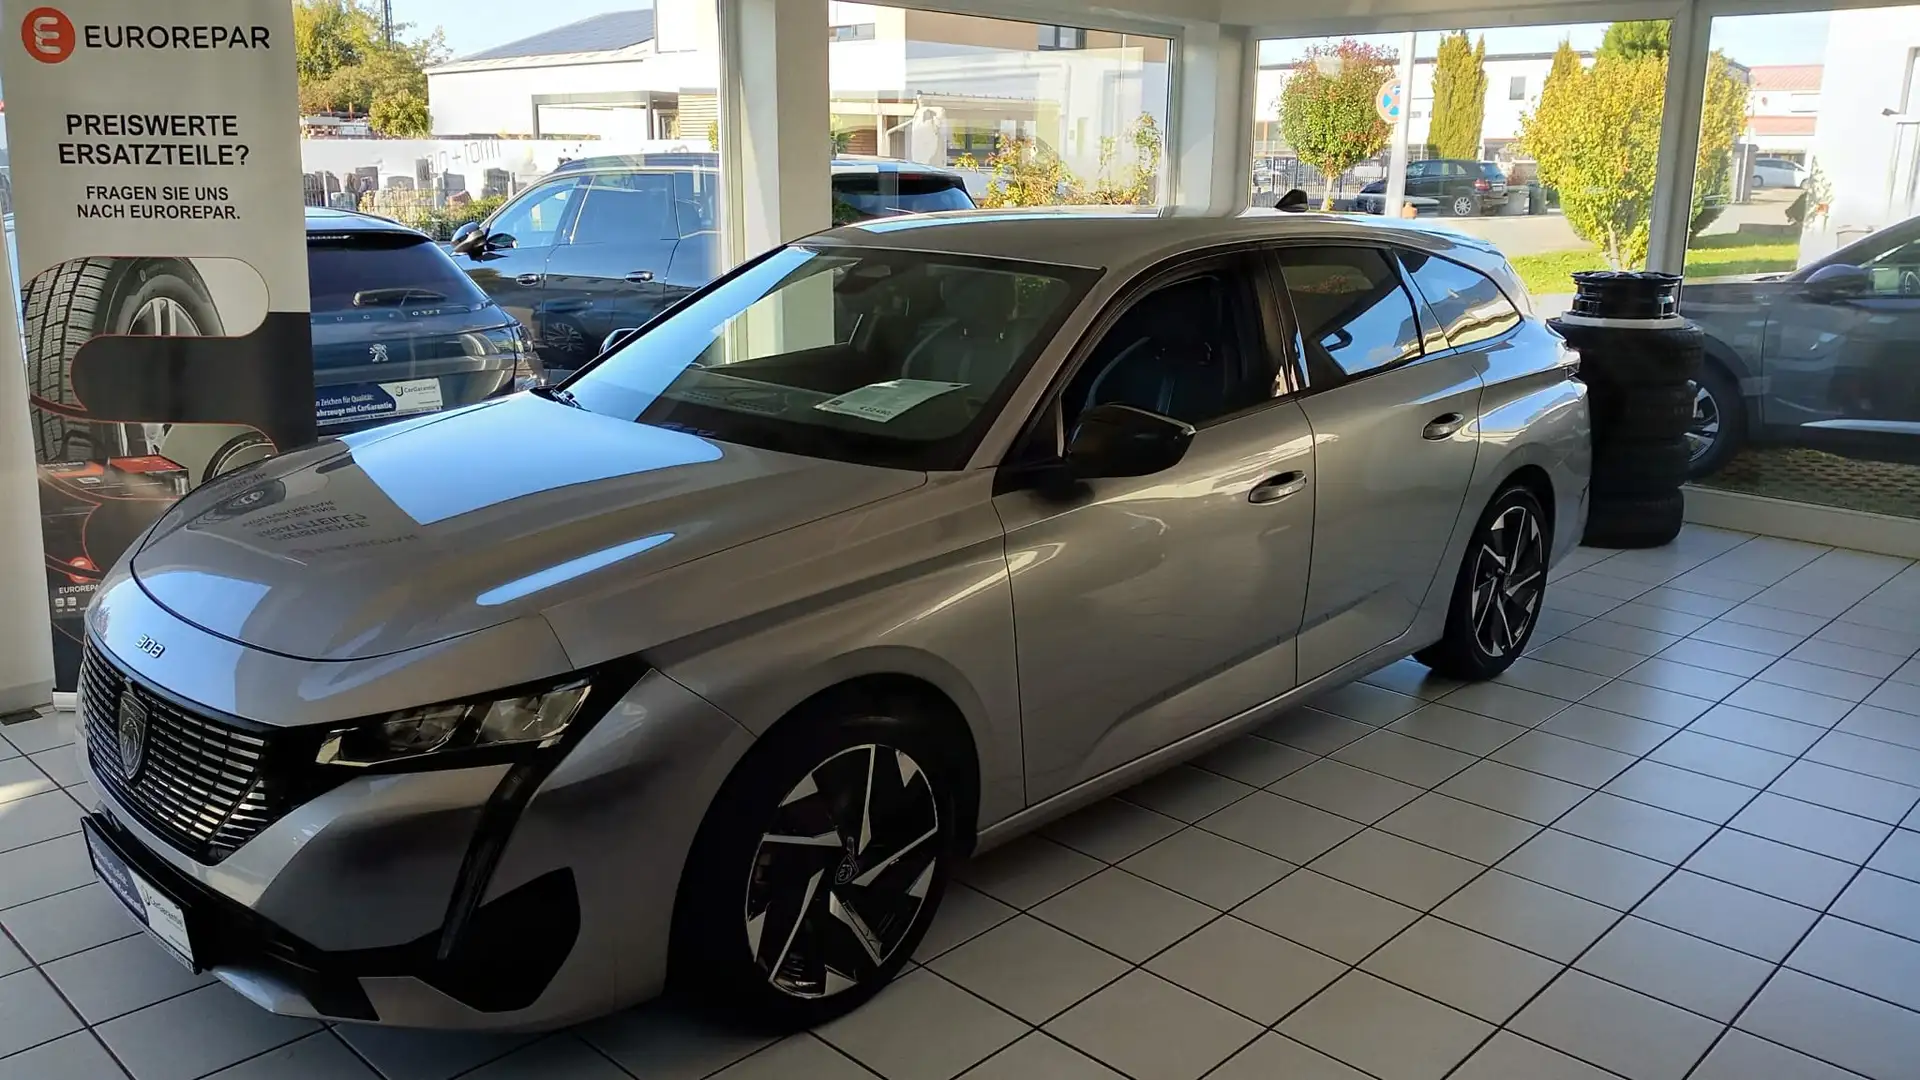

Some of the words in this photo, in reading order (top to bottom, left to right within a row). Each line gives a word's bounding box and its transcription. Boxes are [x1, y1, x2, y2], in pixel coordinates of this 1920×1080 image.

[84, 25, 270, 49] EUROREPAR
[66, 113, 239, 137] PREISWERTE
[58, 143, 250, 166] ERSATZTEILE?
[86, 185, 157, 201] FRAGEN
[162, 186, 190, 201] SIE
[195, 186, 229, 201] UNS
[77, 204, 125, 219] NACH
[130, 205, 241, 220] EUROREPAR.
[316, 406, 346, 417] ahrzeuge
[346, 404, 357, 413] mit
[135, 634, 166, 659] 308
